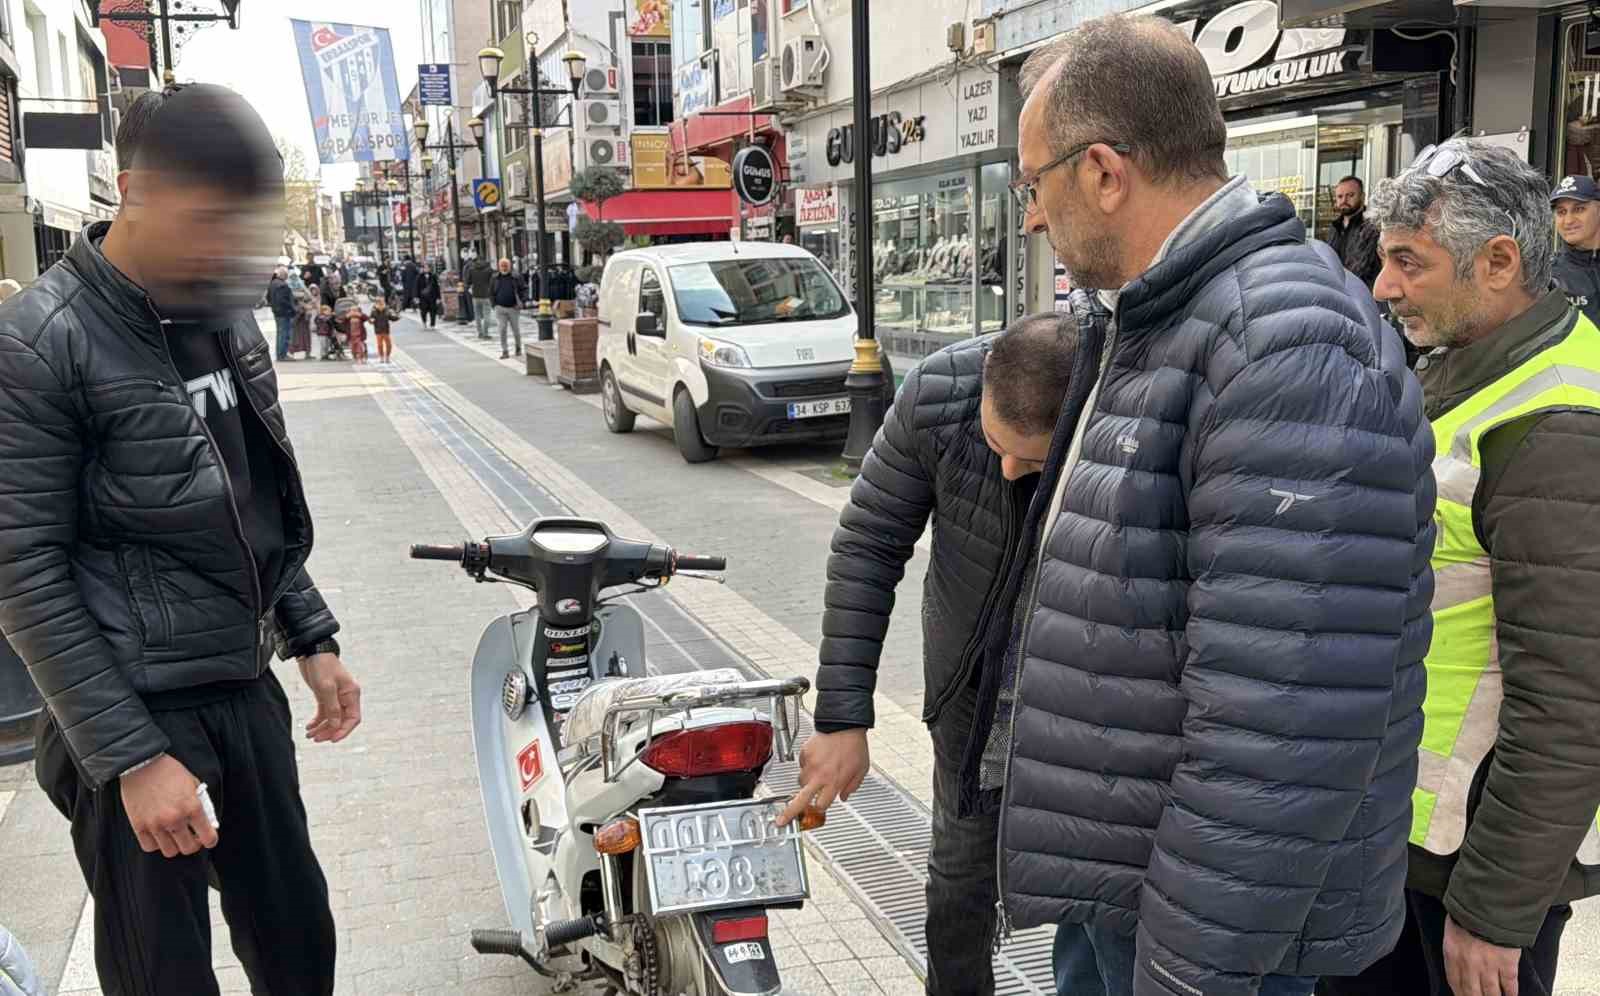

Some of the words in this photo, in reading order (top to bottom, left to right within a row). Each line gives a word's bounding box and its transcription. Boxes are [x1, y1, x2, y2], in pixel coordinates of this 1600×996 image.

[1212, 50, 1347, 97] YUMCULUK
[963, 79, 993, 101] LAZER
[967, 104, 988, 123] YAZI
[826, 111, 901, 167] GUUS
[796, 404, 808, 417] 34
[812, 402, 830, 415] KSP
